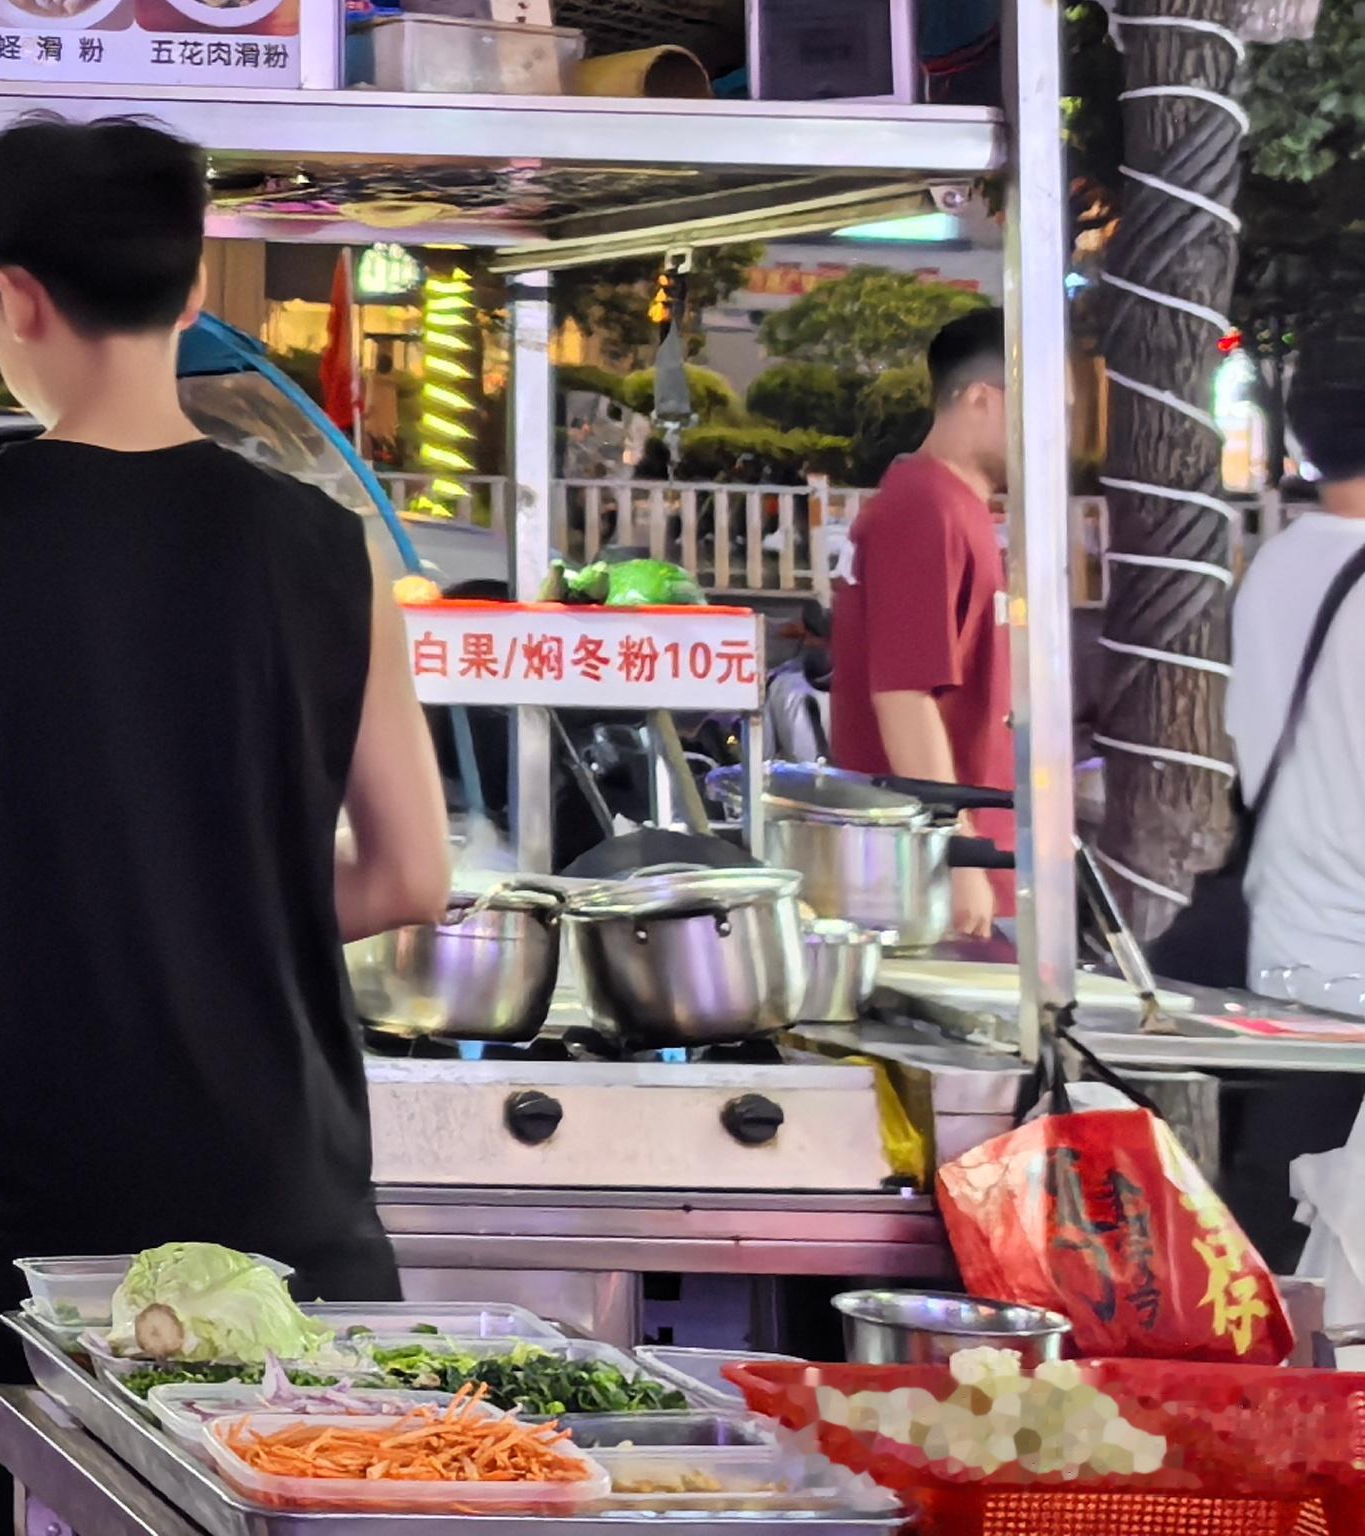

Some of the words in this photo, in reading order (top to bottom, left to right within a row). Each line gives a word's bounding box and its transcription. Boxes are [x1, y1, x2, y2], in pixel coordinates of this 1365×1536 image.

[150, 39, 289, 69] 五花肉滑粉
